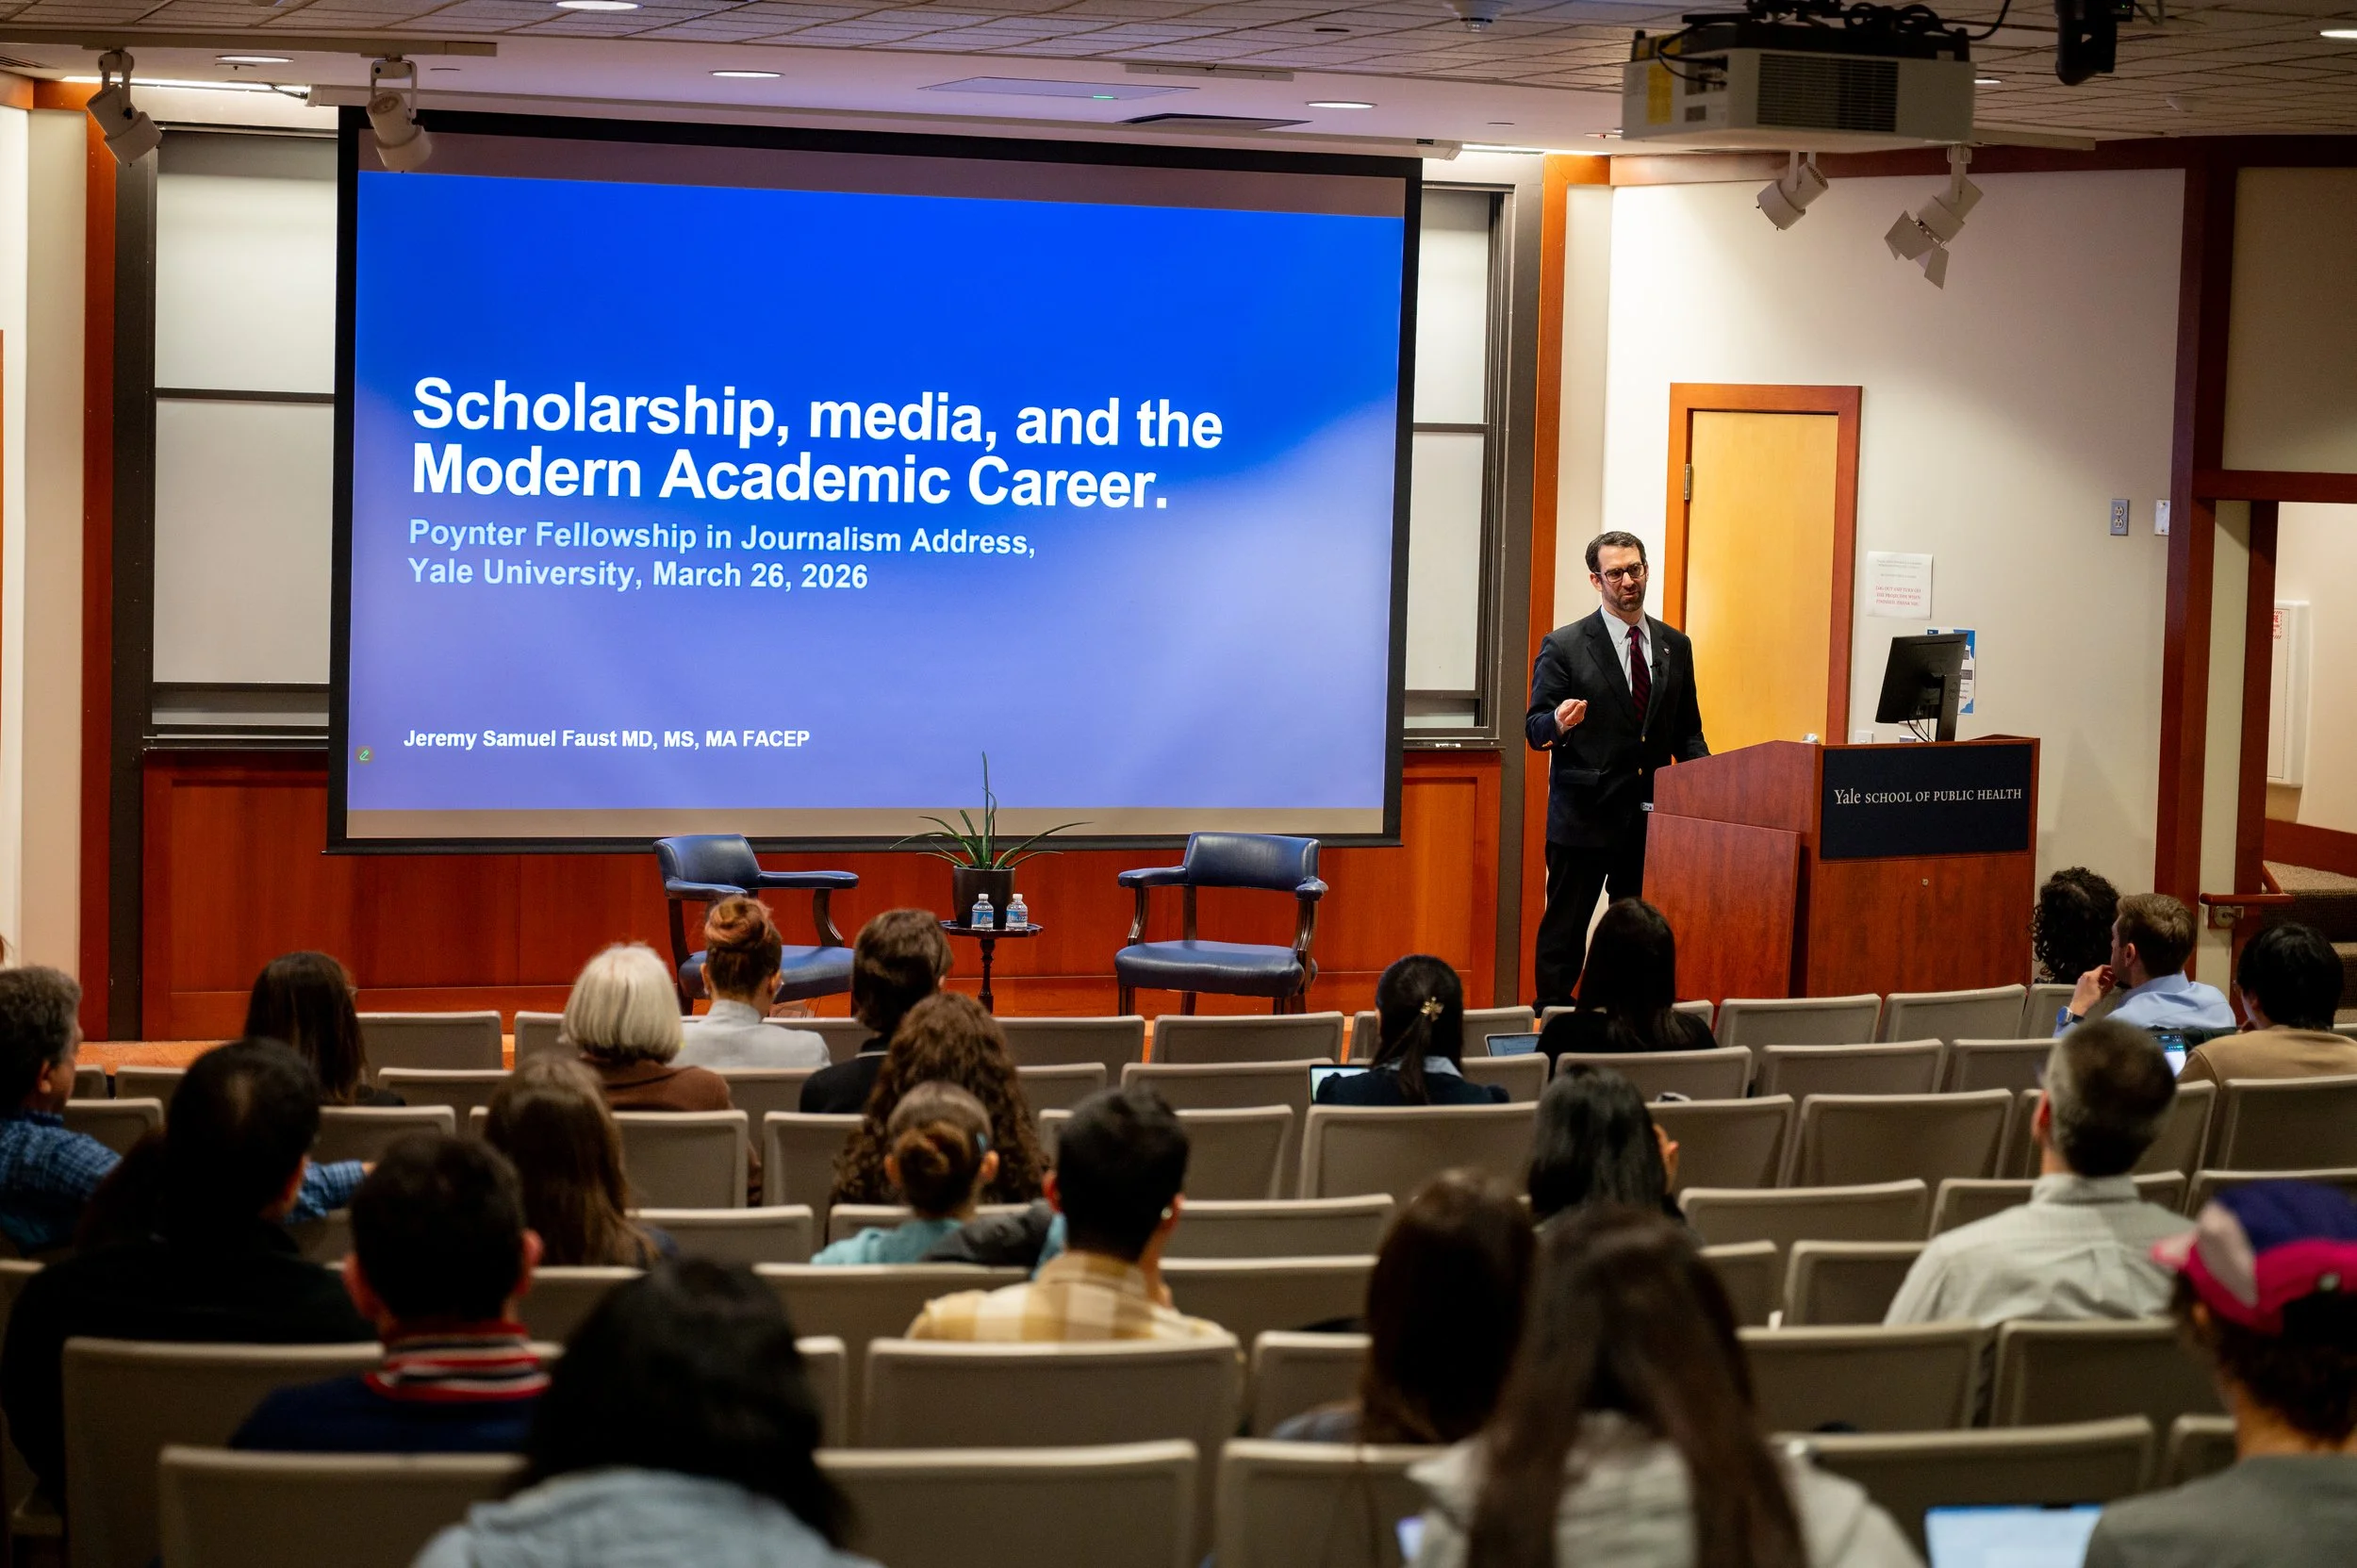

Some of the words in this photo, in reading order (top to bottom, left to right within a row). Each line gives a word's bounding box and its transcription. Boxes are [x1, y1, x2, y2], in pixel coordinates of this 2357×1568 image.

[413, 376, 788, 449] Scholarship,
[810, 391, 997, 453] media,
[1015, 397, 1119, 446] and
[1136, 399, 1223, 449] the
[413, 442, 641, 497] Modern
[658, 449, 950, 504] Academic
[968, 455, 1167, 509] Career.
[410, 519, 527, 552] Poynter
[536, 521, 697, 553] Fellowship
[707, 525, 732, 549] in
[741, 525, 901, 552] Journalism
[910, 528, 1035, 559] Address,
[407, 557, 473, 584] Yale
[484, 558, 642, 592] University,
[653, 561, 741, 587] March
[750, 563, 791, 592] 26,
[801, 563, 868, 589] 2026
[404, 730, 477, 751] Jeremy
[482, 730, 556, 747] Samuel
[562, 730, 618, 747] Faust
[621, 730, 658, 751] MD,
[664, 731, 700, 751] MS,
[705, 730, 737, 747] MA
[743, 730, 810, 748] FACEP
[1834, 788, 1861, 805] Yale
[1865, 791, 1913, 804] SCHOOL
[1915, 790, 1931, 802] OF
[1933, 789, 1974, 801] PUBLIC
[1977, 788, 2022, 801] HEALTH
